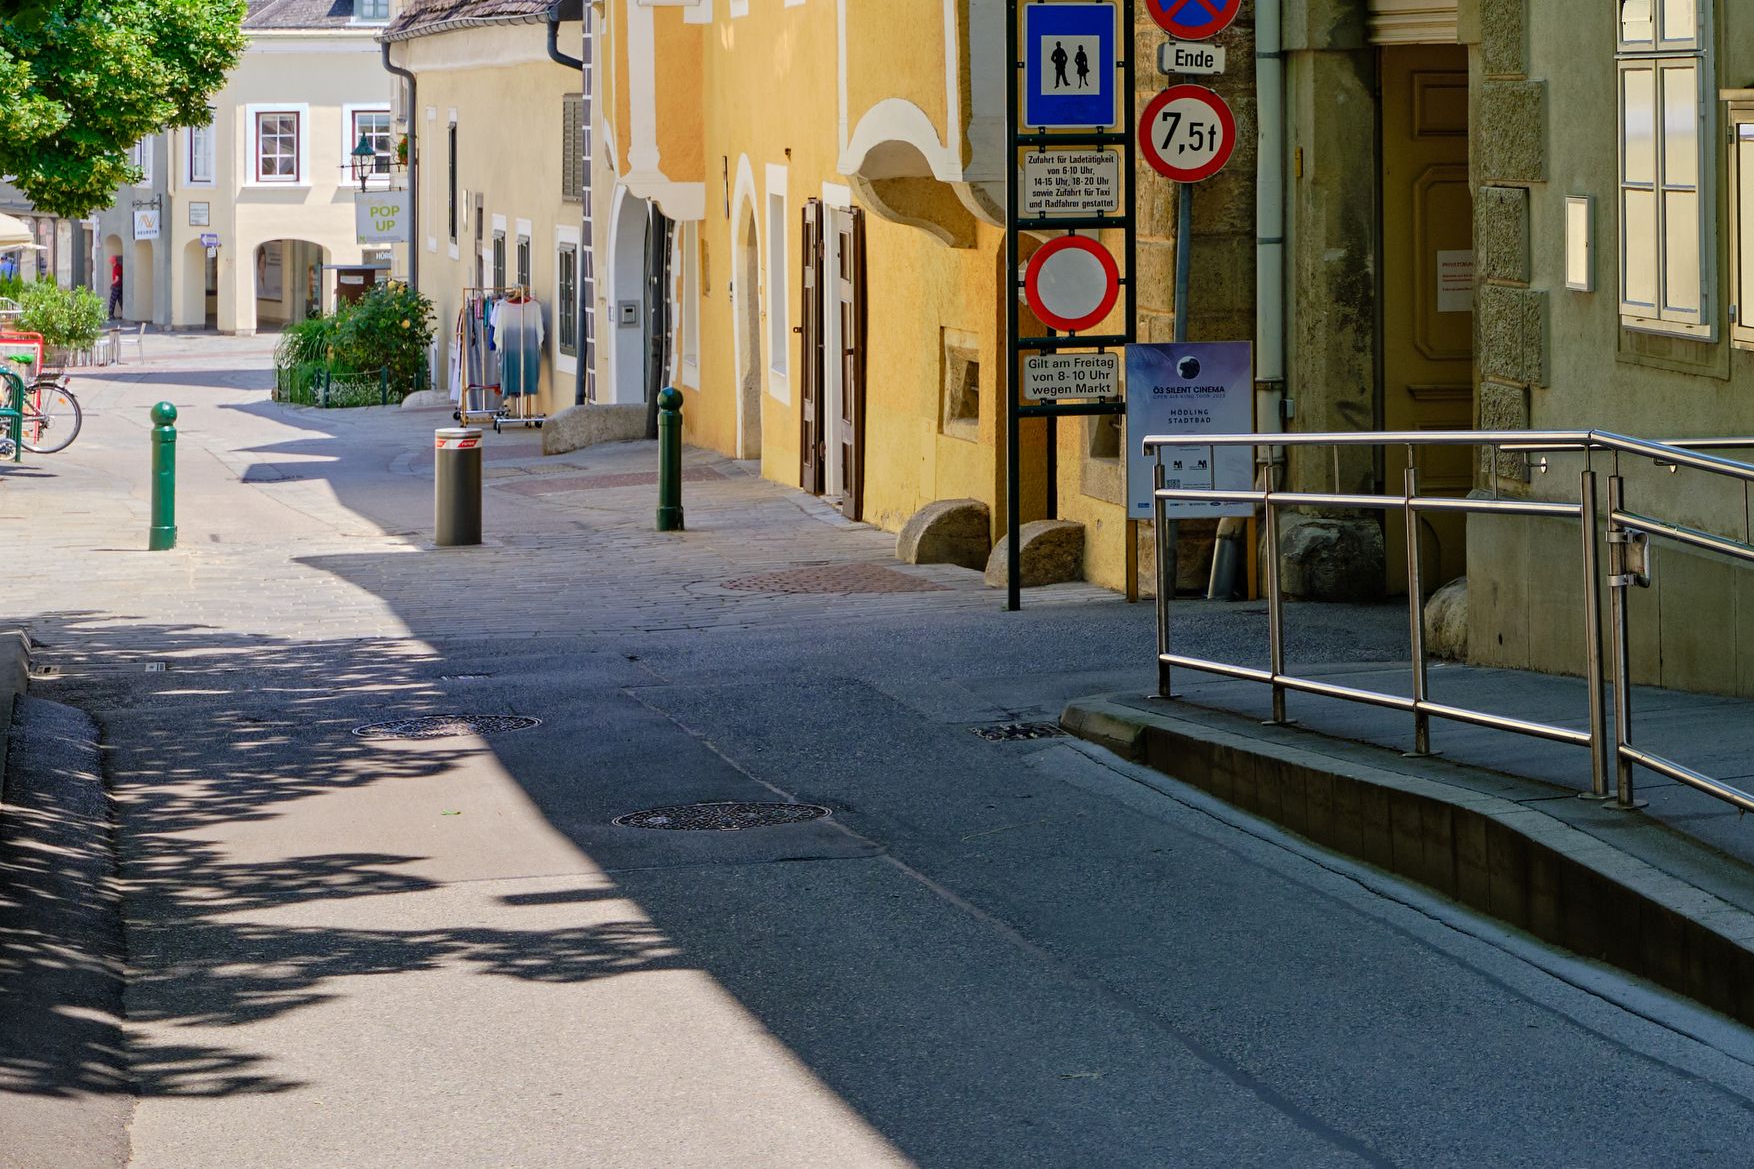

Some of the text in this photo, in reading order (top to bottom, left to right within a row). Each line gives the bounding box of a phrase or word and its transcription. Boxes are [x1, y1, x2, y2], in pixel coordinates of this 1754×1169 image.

[1175, 49, 1214, 68] Ende
[1028, 154, 1114, 165] Zufahrt für Ladetätigkeit
[1080, 166, 1095, 176] Uhr,
[1034, 177, 1052, 186] 14-15
[1055, 177, 1070, 186] Uhr,
[1097, 177, 1109, 185] Uhr
[1032, 187, 1110, 197] sowie Zufahrt für Taxi
[1029, 199, 1113, 209] und Radfahrer gestattet
[370, 206, 400, 218] POP
[375, 220, 395, 232] UP
[1028, 359, 1048, 369] Gilt
[1074, 357, 1114, 369] Freitag
[1089, 370, 1110, 380] Uhr
[1032, 383, 1111, 396] wegen Markt
[1153, 385, 1164, 394] Ö3
[1165, 386, 1191, 394] SILENT
